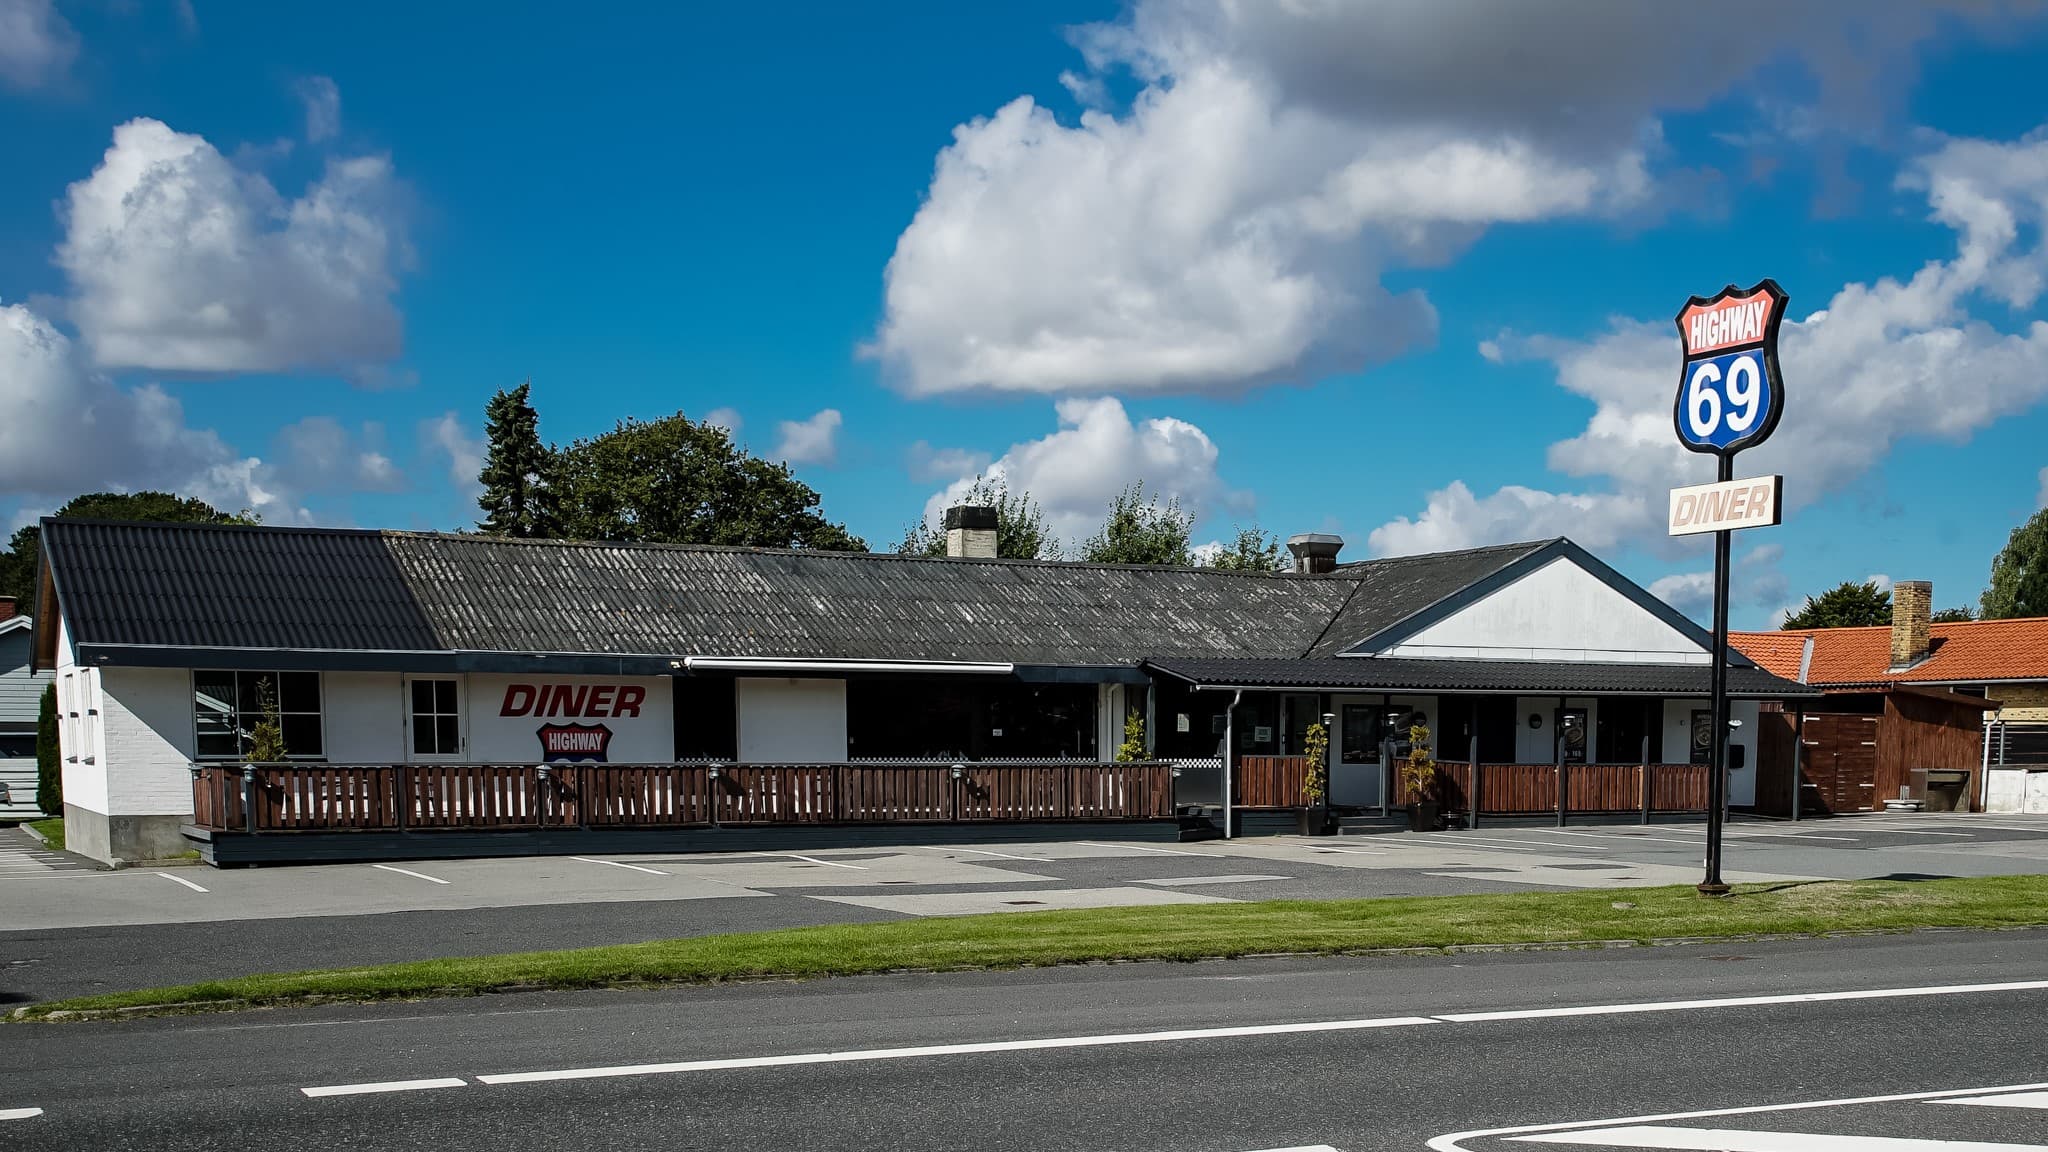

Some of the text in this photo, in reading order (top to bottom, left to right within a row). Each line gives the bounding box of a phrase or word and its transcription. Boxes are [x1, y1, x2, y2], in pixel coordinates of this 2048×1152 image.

[1691, 300, 1766, 350] HIGHWAY
[1689, 356, 1760, 436] 69
[1674, 485, 1770, 526] DINER
[500, 685, 646, 717] DINER
[549, 732, 603, 750] HIGHWAY
